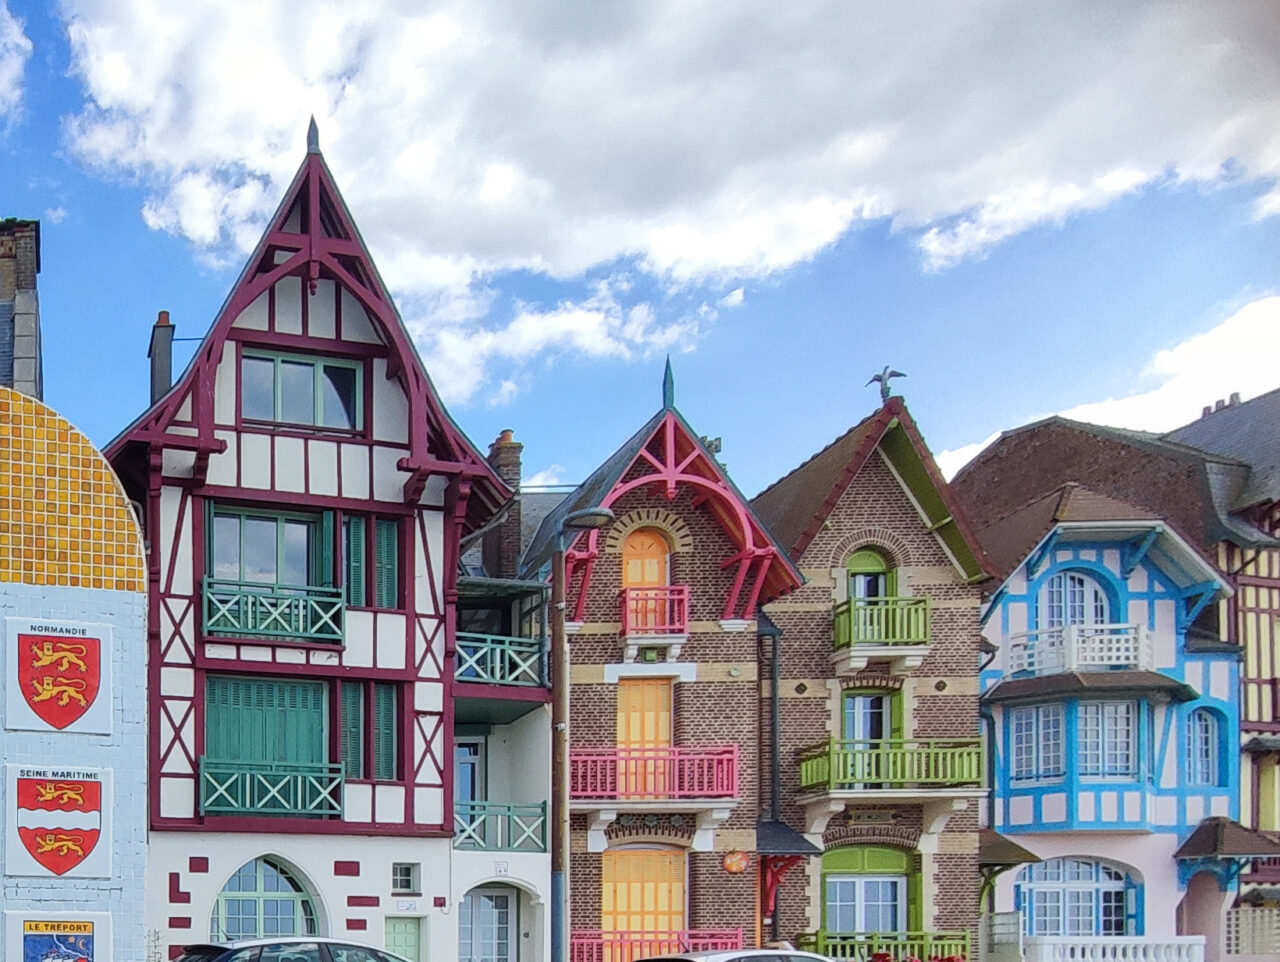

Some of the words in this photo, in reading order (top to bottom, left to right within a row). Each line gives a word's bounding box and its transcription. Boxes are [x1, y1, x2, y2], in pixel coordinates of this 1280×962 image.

[30, 625, 87, 636] NORMANDIE
[20, 769, 49, 778] SEINE
[51, 771, 99, 780] MARITIME
[29, 923, 40, 931] LE
